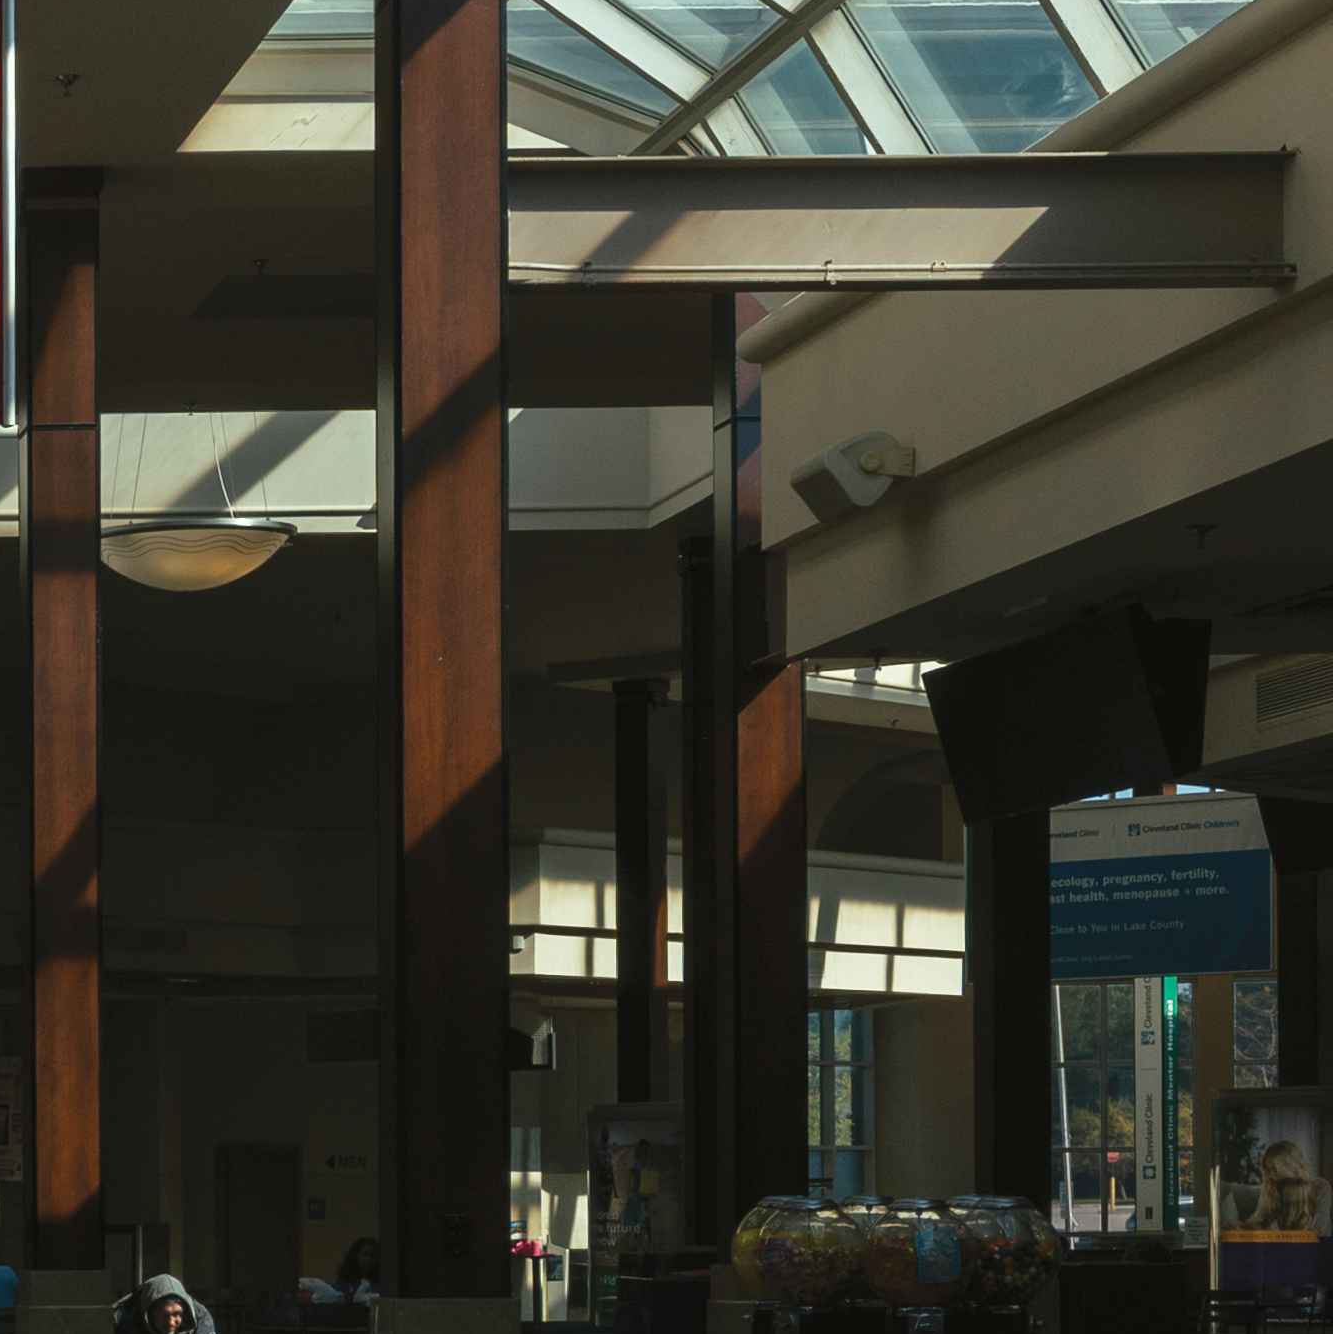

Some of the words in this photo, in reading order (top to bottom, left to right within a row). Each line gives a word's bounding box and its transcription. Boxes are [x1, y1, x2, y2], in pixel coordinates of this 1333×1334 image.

[1142, 823, 1180, 834] Cleveland
[1103, 872, 1167, 886] pregnancy,
[1171, 868, 1220, 881] fertility,
[1069, 890, 1109, 903] health,
[1113, 888, 1179, 900] menopause
[1195, 886, 1230, 896] more.
[1078, 924, 1087, 933] to
[1090, 922, 1108, 933] You
[1111, 921, 1120, 931] in
[1123, 919, 1147, 931] Lake
[1150, 919, 1184, 931] County
[338, 1155, 367, 1168] MEN
